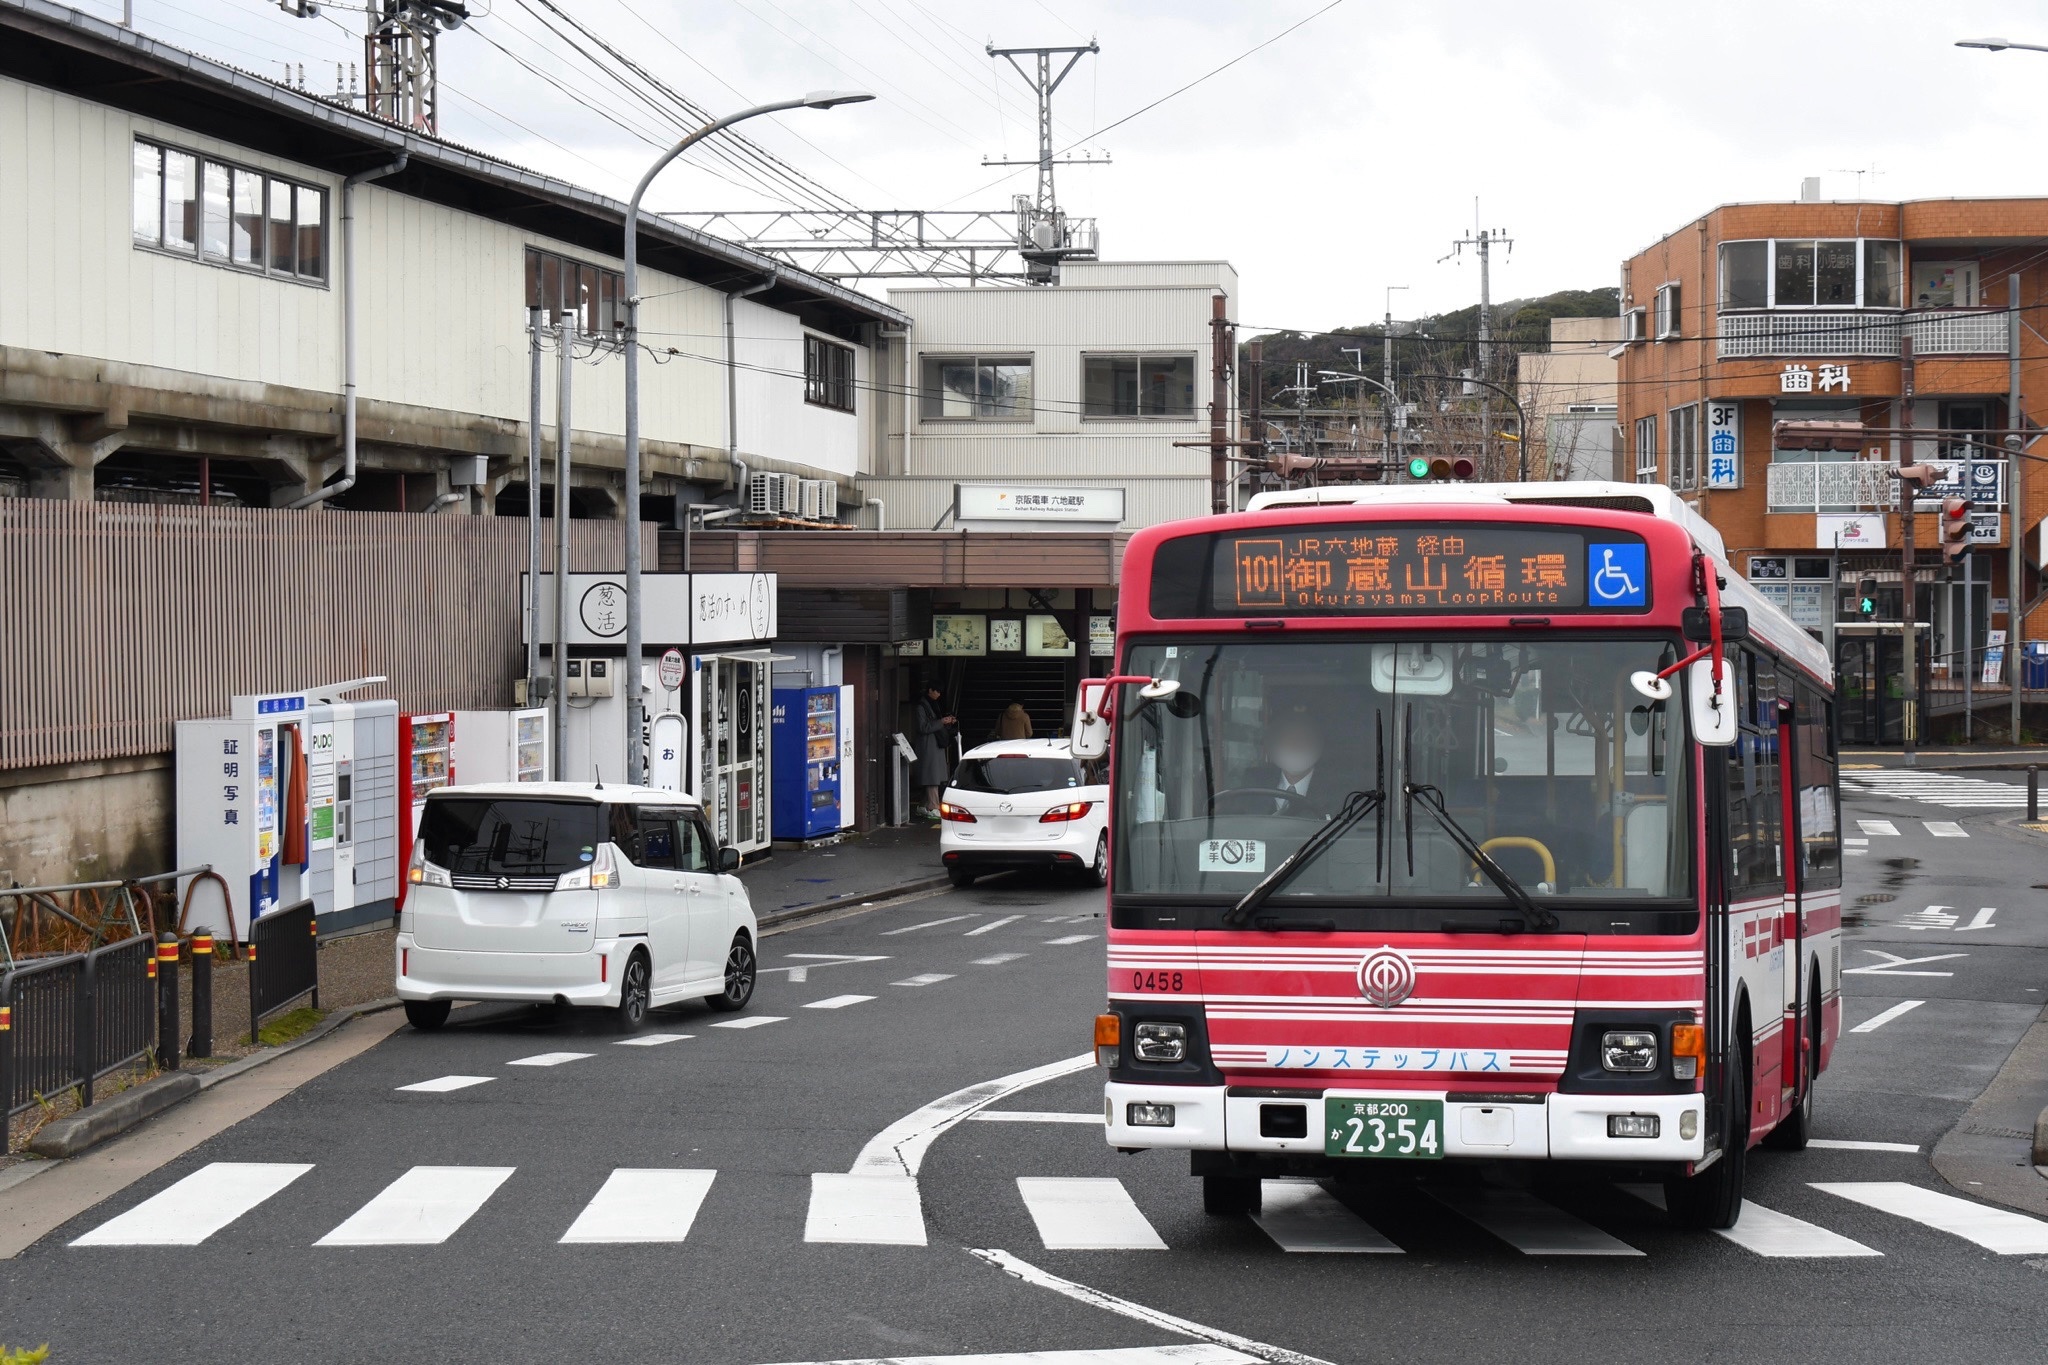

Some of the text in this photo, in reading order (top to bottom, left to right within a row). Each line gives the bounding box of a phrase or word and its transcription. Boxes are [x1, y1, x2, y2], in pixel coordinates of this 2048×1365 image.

[1780, 364, 1851, 392] 歯科
[1712, 407, 1735, 426] 3F
[1711, 430, 1736, 483] 歯科
[1015, 494, 1085, 506] 京阪電車 六地蔵駅
[1290, 535, 1464, 556] JR六地蔵 経由
[1241, 555, 1278, 592] 101
[1285, 554, 1567, 592] 御蔵山循環
[597, 586, 616, 630] 葱活
[1299, 591, 1426, 605] Okurayama
[313, 734, 333, 749] PUDO
[223, 739, 239, 825] 証明写真
[1209, 841, 1219, 863] 挙手
[1245, 841, 1256, 863] 挨拶
[1133, 971, 1183, 991] 0458
[1274, 1048, 1501, 1072] ノンステップバス
[1353, 1103, 1408, 1116] 京都200
[1331, 1117, 1438, 1154] か 23-54
